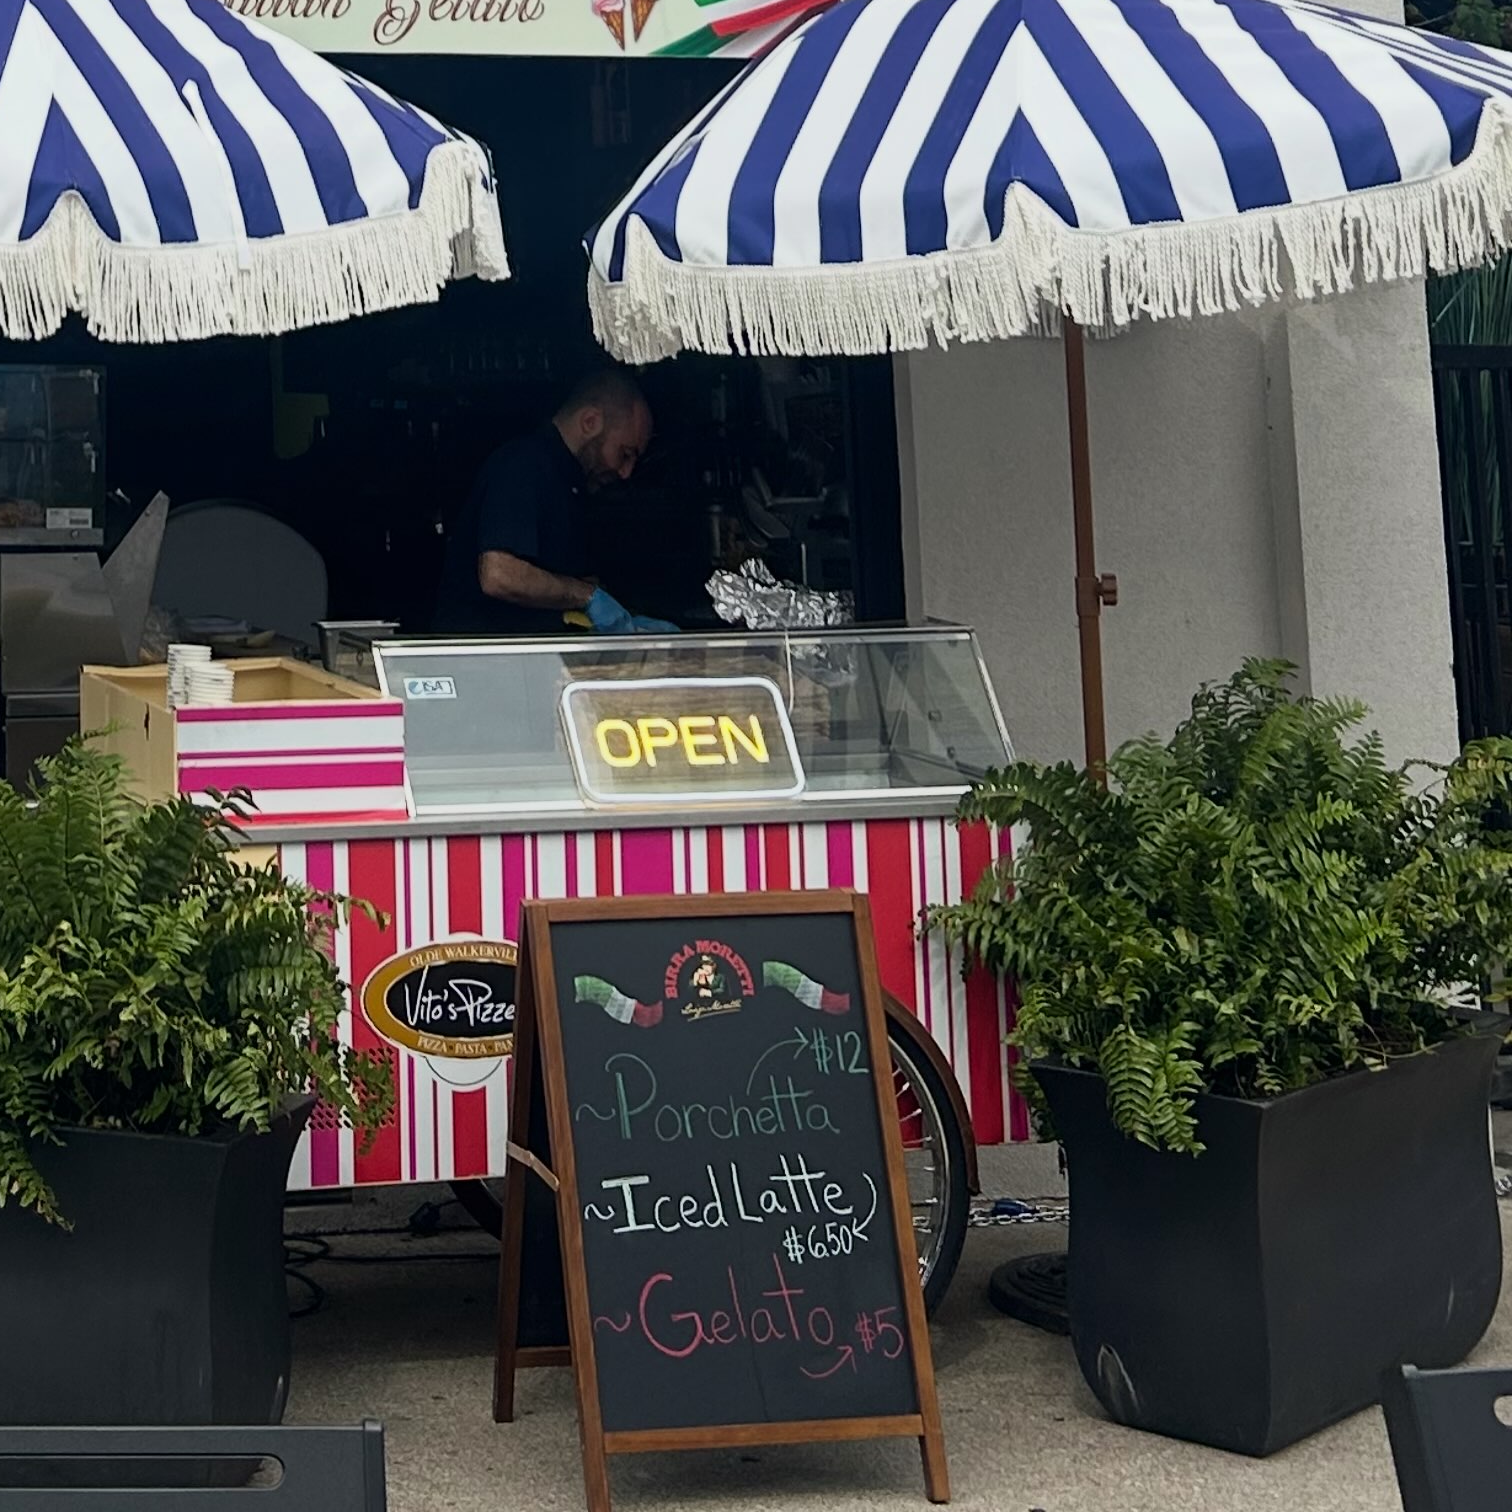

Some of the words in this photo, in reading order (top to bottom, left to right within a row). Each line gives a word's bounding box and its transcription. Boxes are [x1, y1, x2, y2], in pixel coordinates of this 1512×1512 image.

[595, 715, 769, 767] OPEN
[410, 952, 442, 967] OLDE
[665, 945, 695, 999] BIRRA
[696, 940, 755, 997] MORETTI
[404, 965, 458, 1026] Vito's
[418, 1036, 447, 1052] PIZZA
[455, 1043, 486, 1054] PASTA
[811, 1029, 869, 1075] $12
[639, 1253, 834, 1357] Gelato
[855, 1307, 904, 1359] $5
